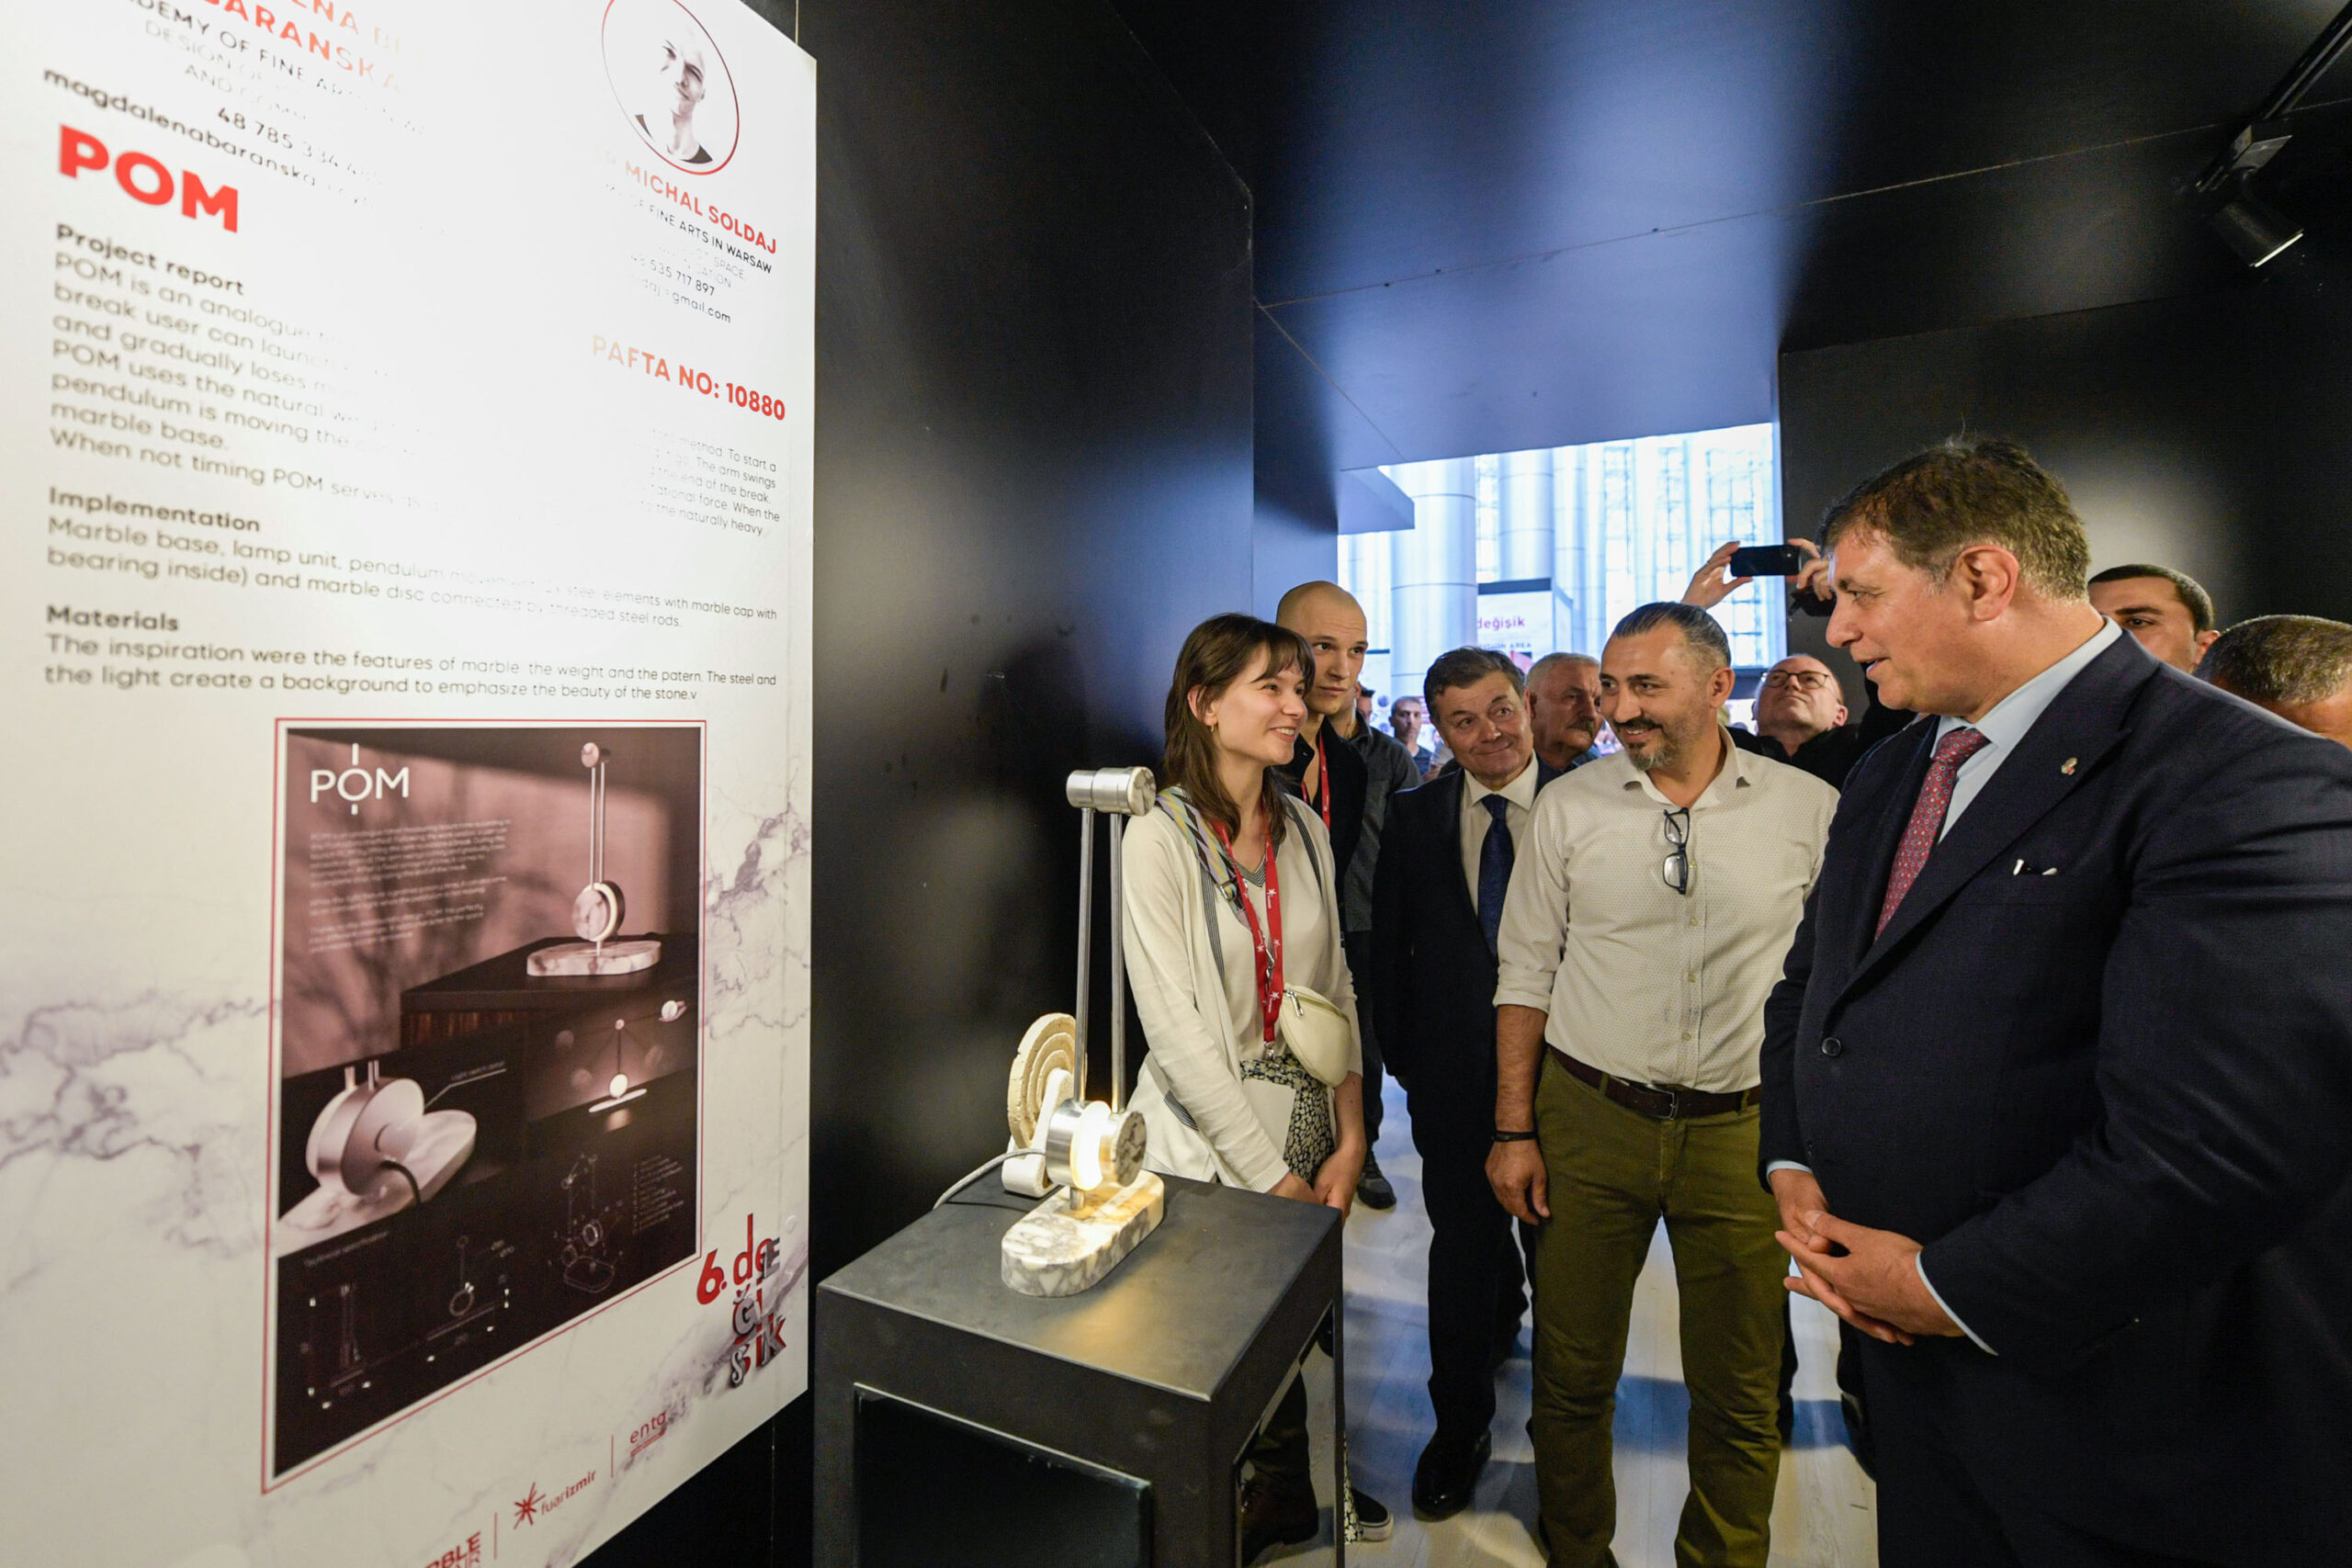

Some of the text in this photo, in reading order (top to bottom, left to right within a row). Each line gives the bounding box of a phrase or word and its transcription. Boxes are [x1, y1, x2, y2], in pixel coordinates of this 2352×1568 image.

[220, 30, 250, 53] OF
[259, 49, 305, 81] FINE
[217, 107, 245, 130] 48
[254, 120, 293, 149] 785
[59, 123, 239, 234] POM
[625, 160, 703, 216] MICHAL
[708, 205, 776, 254] SOLDAJ
[56, 222, 244, 296] Project report
[679, 220, 708, 243] ARTS
[711, 236, 722, 251] IN
[726, 242, 772, 275] WARSAW
[54, 251, 123, 288] POM
[130, 276, 150, 296] is
[158, 286, 193, 307] an
[676, 270, 692, 287] 717
[695, 279, 715, 297] 897
[54, 282, 138, 319] break
[145, 309, 199, 335] user
[208, 326, 254, 350] can
[51, 314, 111, 342] and
[119, 328, 244, 377] gradually
[251, 360, 308, 389] loses
[593, 333, 786, 421] PAFTA NO: 10880
[52, 339, 120, 369] POM
[128, 358, 187, 387] uses
[195, 374, 236, 398] the
[243, 388, 324, 420] natural
[51, 371, 191, 416] pendulum
[198, 402, 217, 422] is
[224, 410, 309, 444] moving
[51, 401, 230, 451] marble base.
[49, 427, 132, 459] When
[139, 446, 183, 469] not
[191, 455, 266, 486] timing
[272, 468, 324, 492] POM
[718, 465, 740, 479] arm
[743, 472, 776, 490] swings
[728, 448, 740, 462] To
[743, 455, 766, 469] start
[769, 462, 776, 473] a
[48, 487, 261, 533] Implementation
[720, 482, 736, 496] the
[733, 502, 762, 518] When
[763, 510, 780, 523] the
[730, 518, 763, 537] heavy
[47, 547, 160, 581] bearing
[168, 562, 248, 587] inside)
[255, 570, 300, 589] and
[307, 572, 379, 598] marble
[386, 584, 424, 603] disc
[618, 608, 649, 625] steel
[48, 516, 148, 547] Marble
[232, 540, 292, 570] lamp
[348, 558, 444, 581] pendulum
[664, 595, 688, 610] with
[691, 598, 731, 615] marble
[733, 606, 754, 621] cap
[756, 605, 778, 620] with
[46, 604, 178, 632] Materials
[45, 633, 98, 656] The
[108, 637, 244, 662] inspiration
[251, 649, 306, 666] were
[313, 649, 347, 667] the
[353, 651, 434, 671] features
[439, 657, 456, 671] of
[528, 662, 553, 675] the
[558, 664, 604, 680] weight
[608, 666, 635, 680] and
[638, 668, 659, 682] the
[707, 671, 727, 684] The
[729, 672, 754, 685] steel
[757, 673, 776, 686] and
[45, 664, 93, 684] the
[101, 665, 160, 690] light
[170, 669, 252, 689] create
[259, 676, 275, 690] a
[282, 672, 409, 694] background
[414, 680, 434, 694] to
[438, 680, 527, 697] emphasize
[533, 683, 557, 696] the
[561, 684, 610, 700] beauty
[615, 686, 628, 698] of
[631, 686, 652, 699] the
[311, 766, 410, 804] POM
[541, 1471, 596, 1517] fuarizmir
